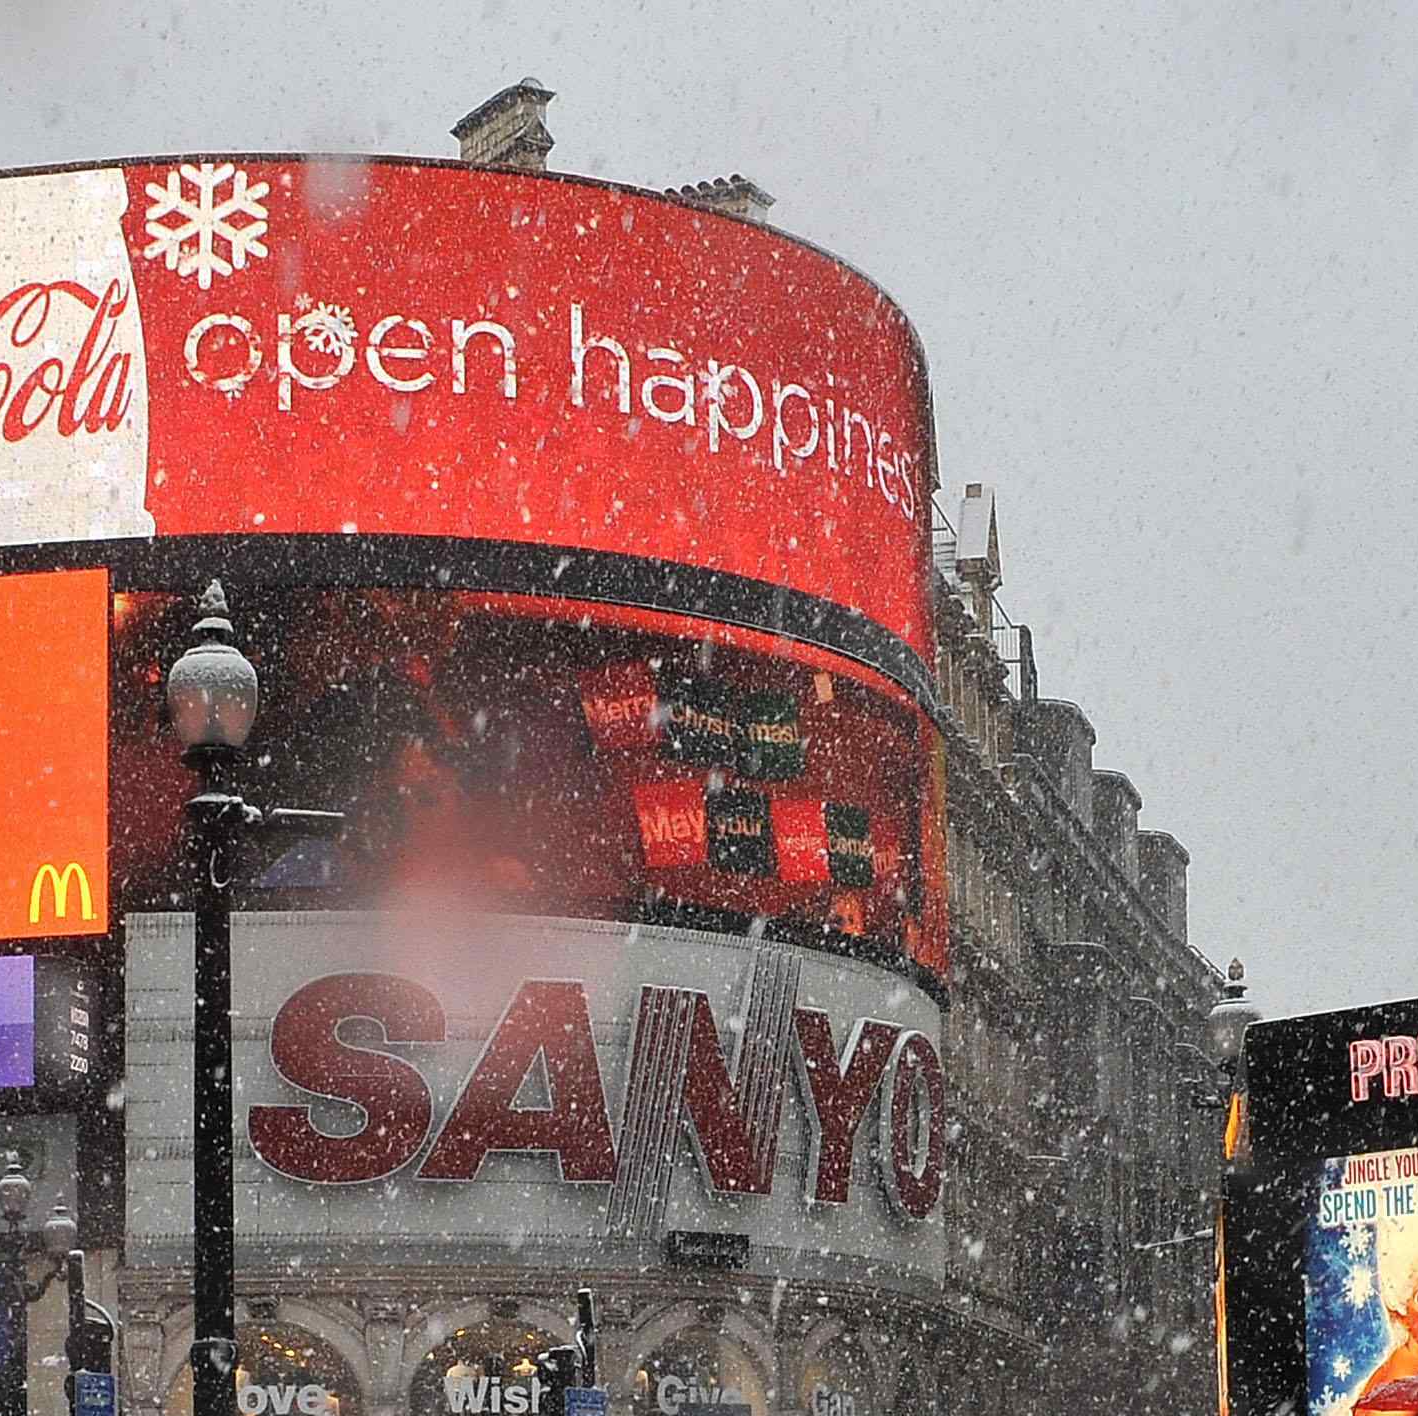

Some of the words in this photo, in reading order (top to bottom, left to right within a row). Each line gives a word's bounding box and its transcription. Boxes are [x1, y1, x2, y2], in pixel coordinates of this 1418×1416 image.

[184, 312, 519, 411] open
[571, 302, 915, 521] happines
[642, 805, 707, 846] May
[247, 972, 944, 1222] SANYO
[1344, 1158, 1391, 1185] JINGLE
[1322, 1190, 1377, 1224] SPEND
[1382, 1184, 1415, 1218] THE
[236, 1383, 328, 1416] ove
